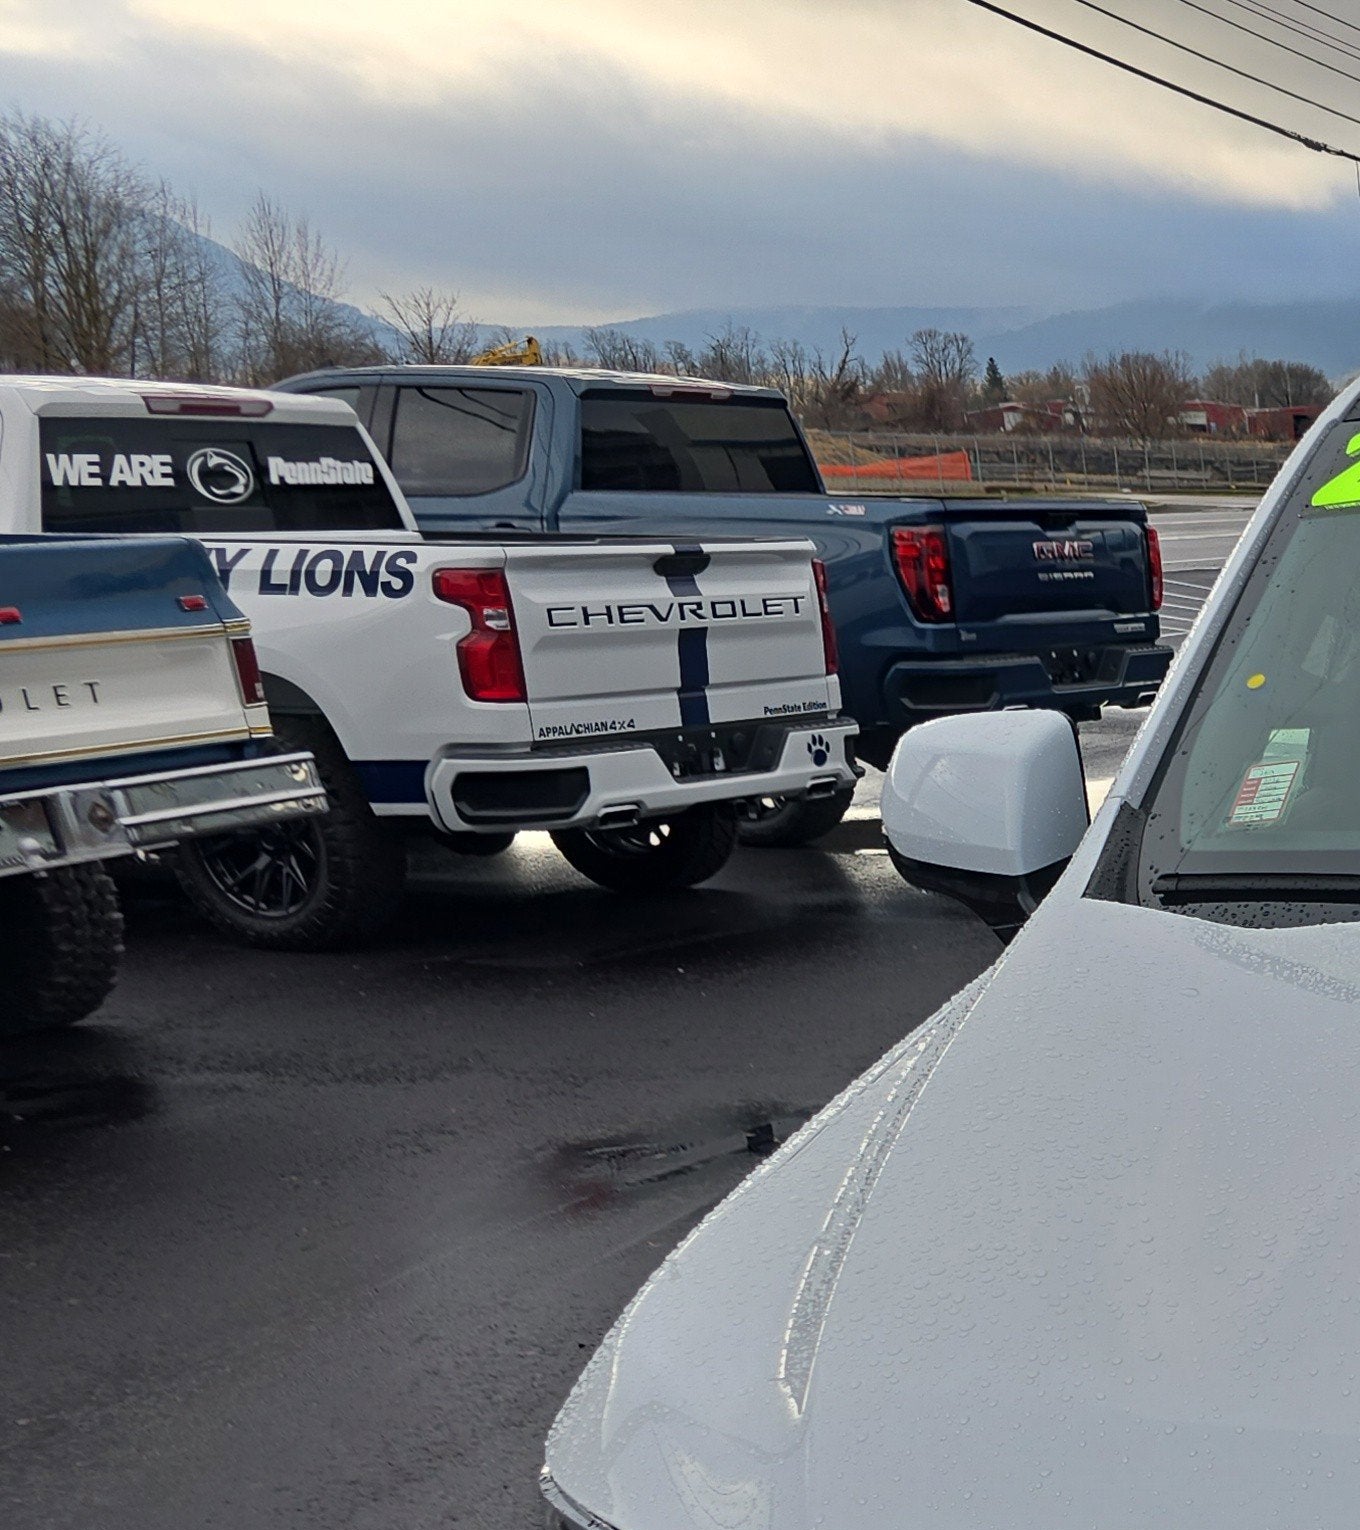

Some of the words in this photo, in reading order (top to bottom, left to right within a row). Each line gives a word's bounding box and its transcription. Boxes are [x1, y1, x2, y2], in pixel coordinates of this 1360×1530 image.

[46, 453, 102, 487] WE
[109, 454, 175, 487] ARE
[206, 547, 252, 593] Y
[259, 548, 418, 599] LIONS
[546, 596, 805, 627] CHEVROLET
[0, 681, 100, 713] LET
[538, 720, 608, 739] APPALACHIAN
